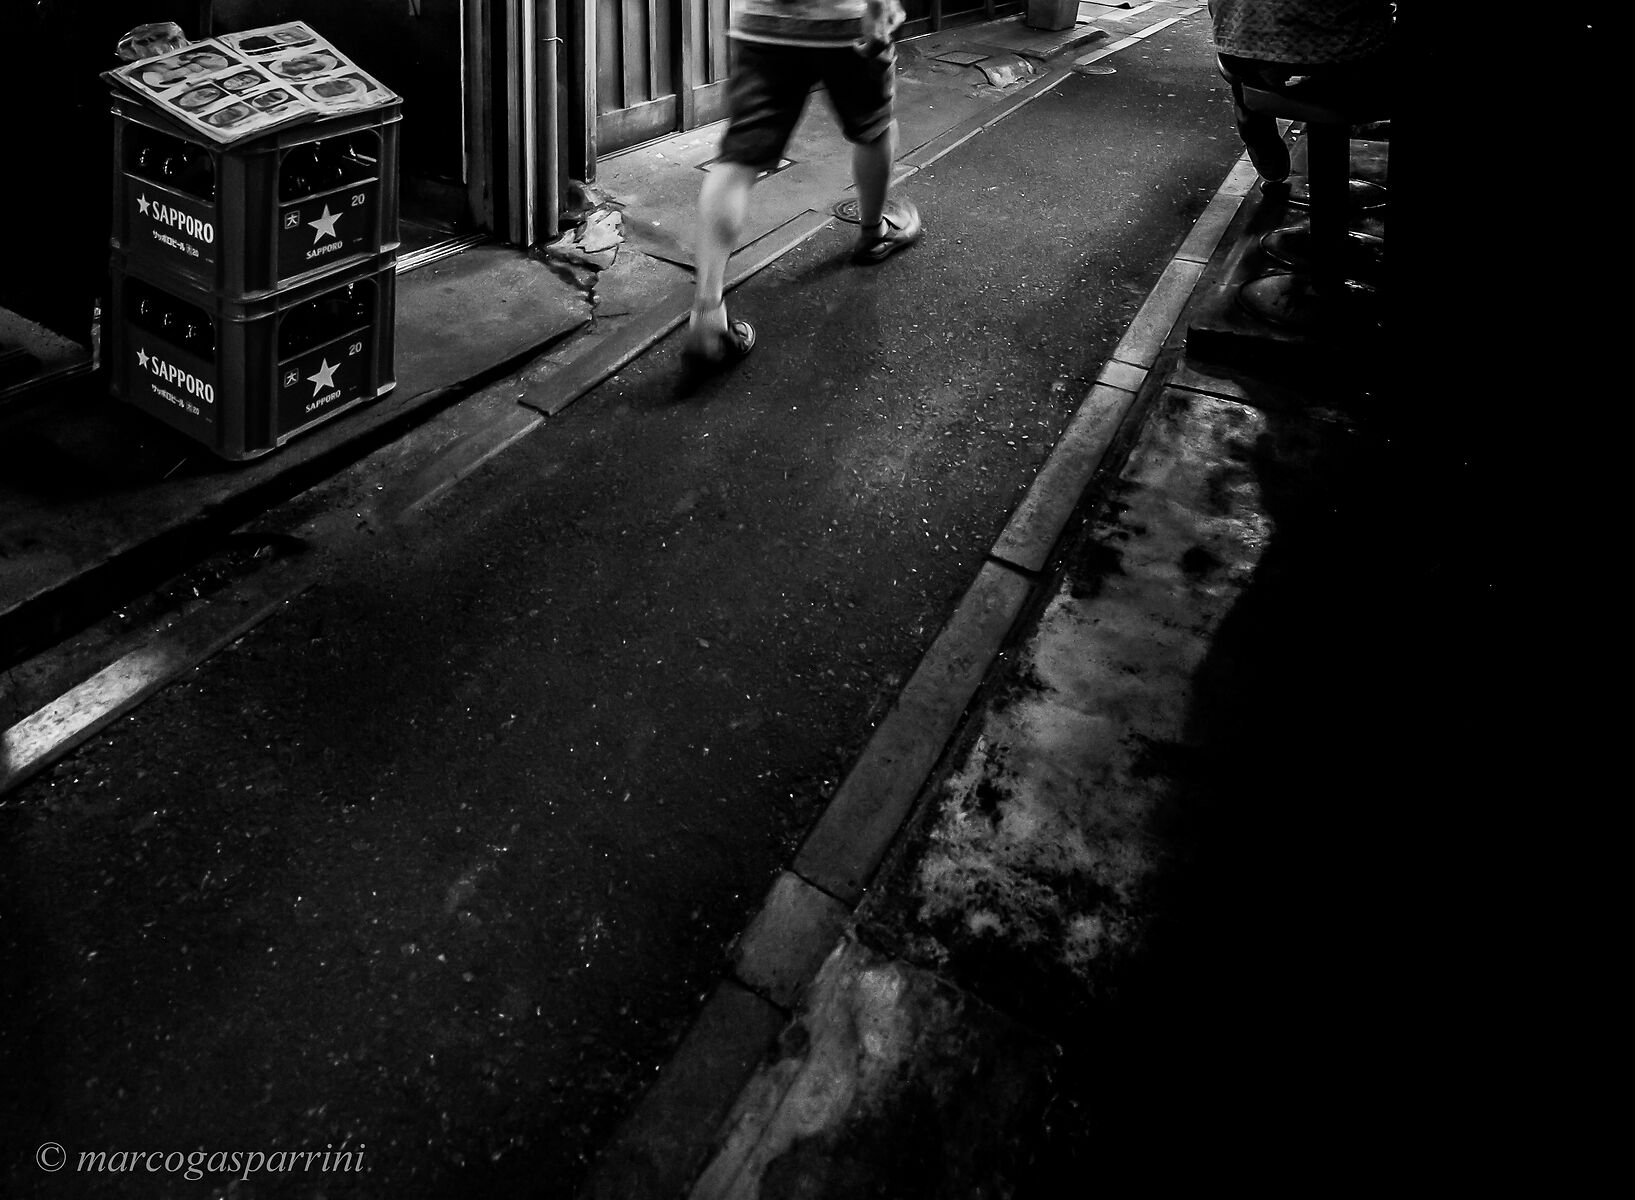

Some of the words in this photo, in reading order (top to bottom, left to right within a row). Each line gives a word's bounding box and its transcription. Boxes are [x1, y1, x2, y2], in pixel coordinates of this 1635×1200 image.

[351, 193, 365, 207] 20
[152, 200, 214, 244] SAPPORO
[286, 213, 298, 227] 大
[306, 240, 343, 260] SAPPORO
[348, 341, 362, 356] 20
[151, 355, 214, 404] SAPPORO
[305, 389, 341, 413] SAPPORO
